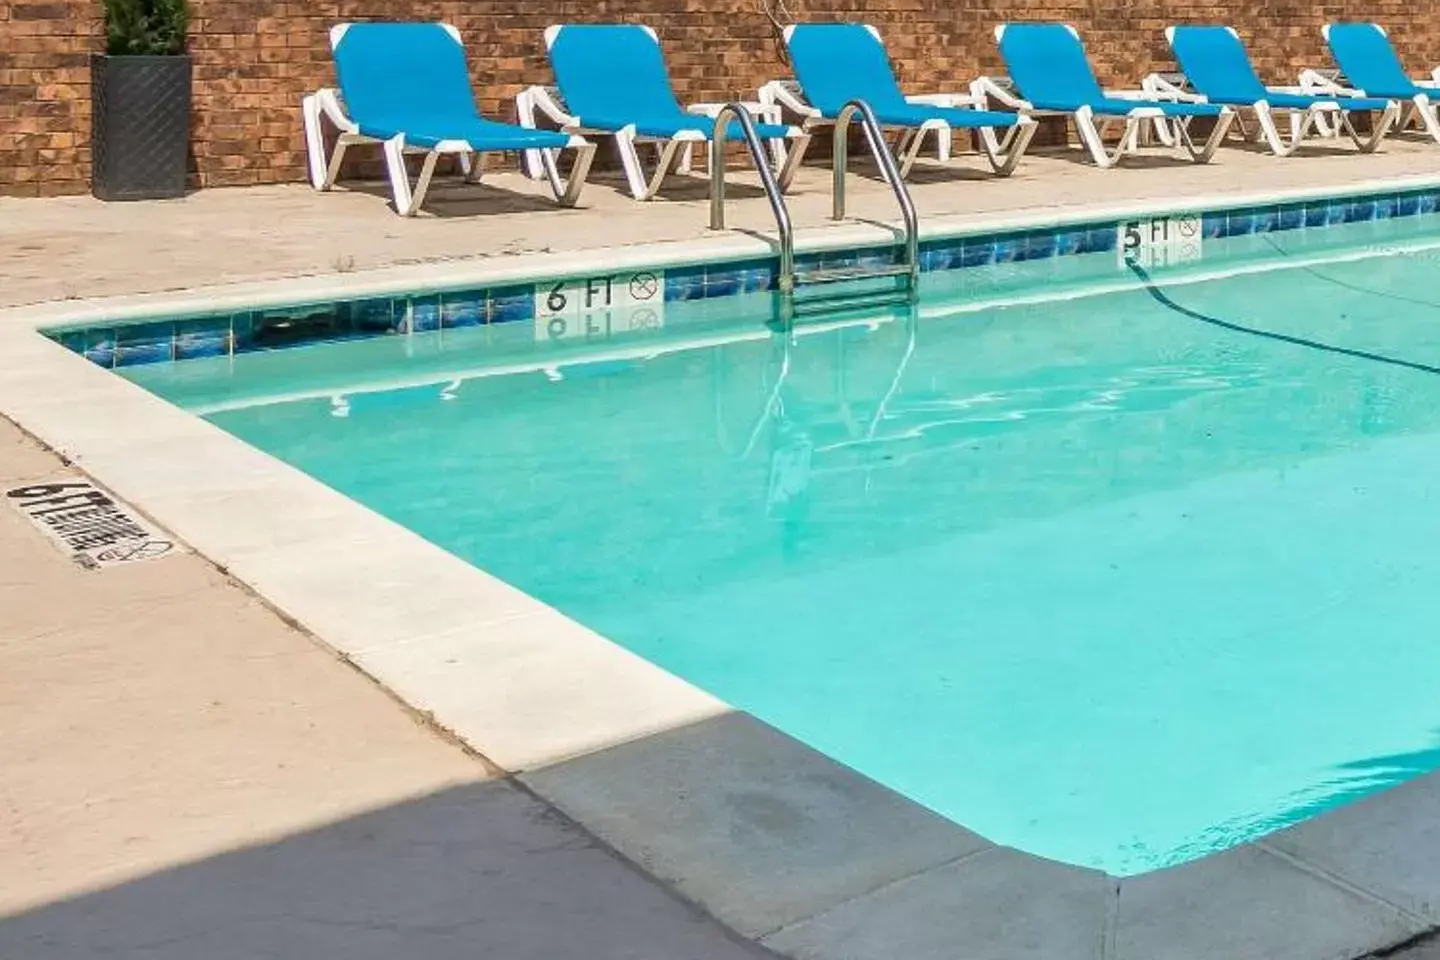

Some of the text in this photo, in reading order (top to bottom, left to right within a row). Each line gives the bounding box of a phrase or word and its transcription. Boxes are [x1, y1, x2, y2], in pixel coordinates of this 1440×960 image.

[1124, 216, 1170, 248] 5 FT
[547, 274, 616, 311] 6 FT
